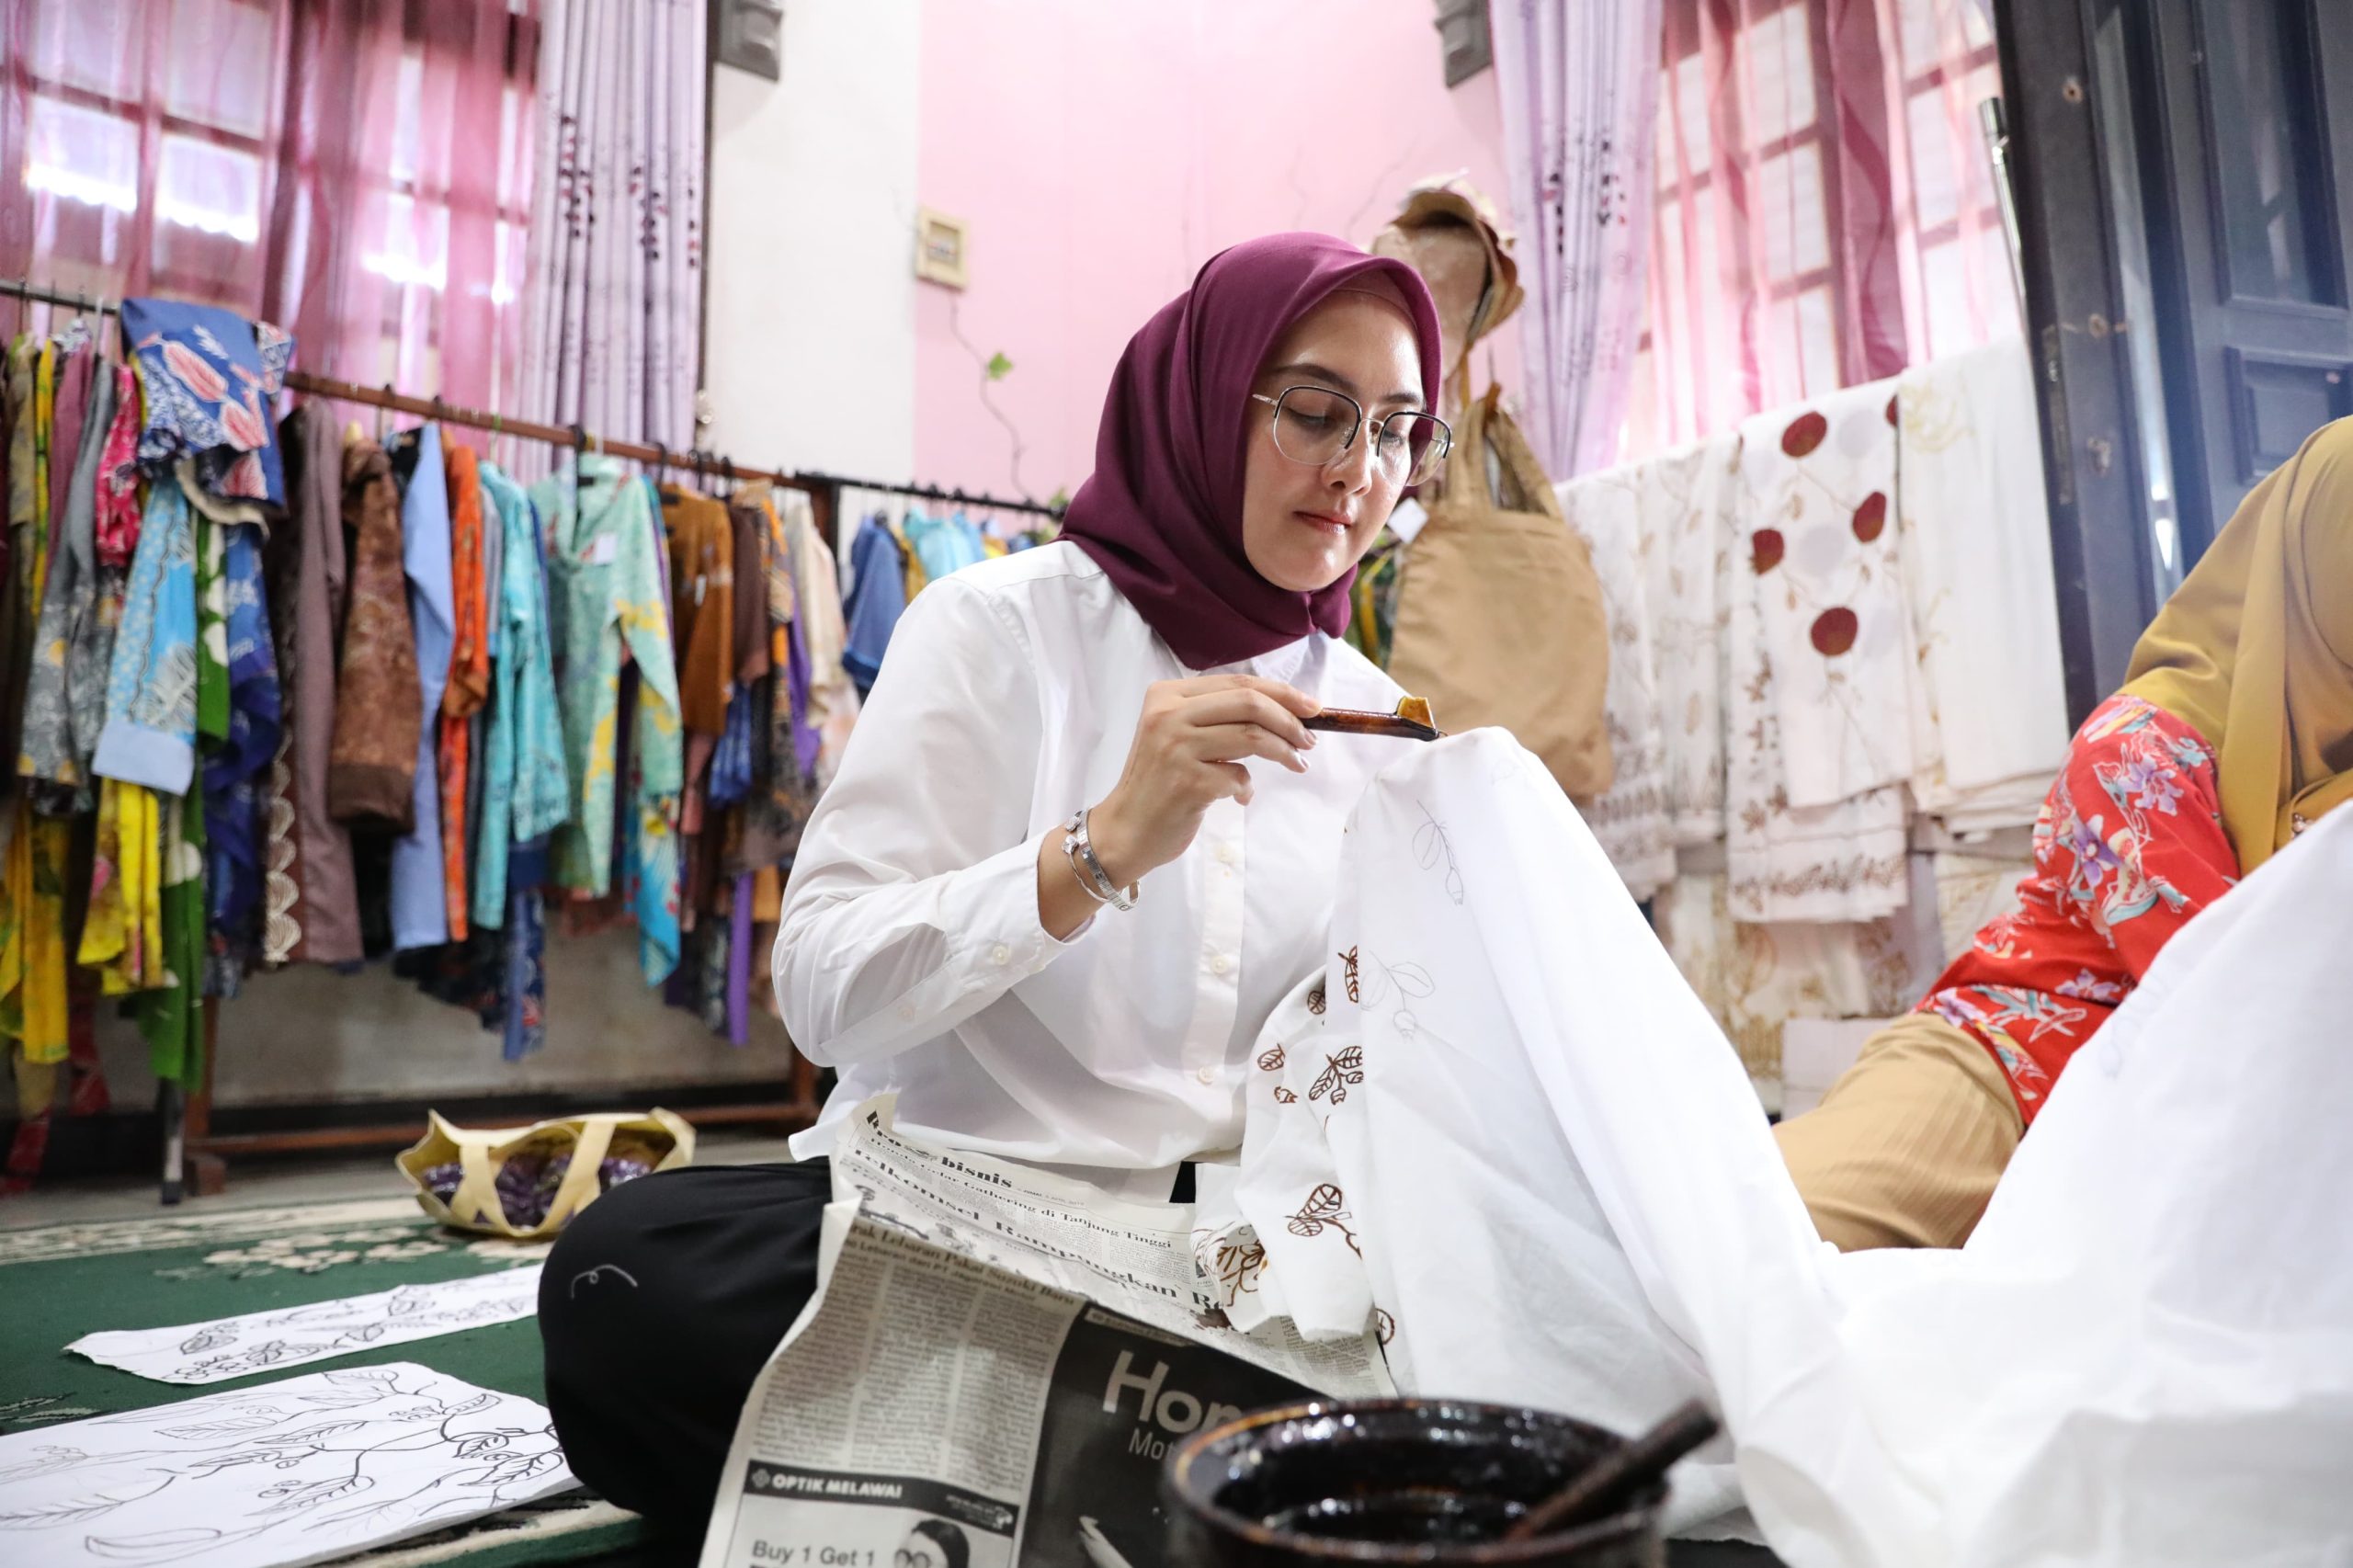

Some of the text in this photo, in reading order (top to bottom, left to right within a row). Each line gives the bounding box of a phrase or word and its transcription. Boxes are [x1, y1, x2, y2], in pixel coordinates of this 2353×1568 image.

[855, 1148, 980, 1221] Telkomsel
[941, 1156, 1012, 1187] bisnis
[964, 1181, 1037, 1213] Gathering
[1040, 1209, 1055, 1218] di
[1060, 1212, 1120, 1238] Tanjung
[1123, 1231, 1172, 1248] Tinggi
[772, 1473, 903, 1498] OPTIK MELAWAI
[752, 1540, 875, 1566] Buy 1 Get 1
